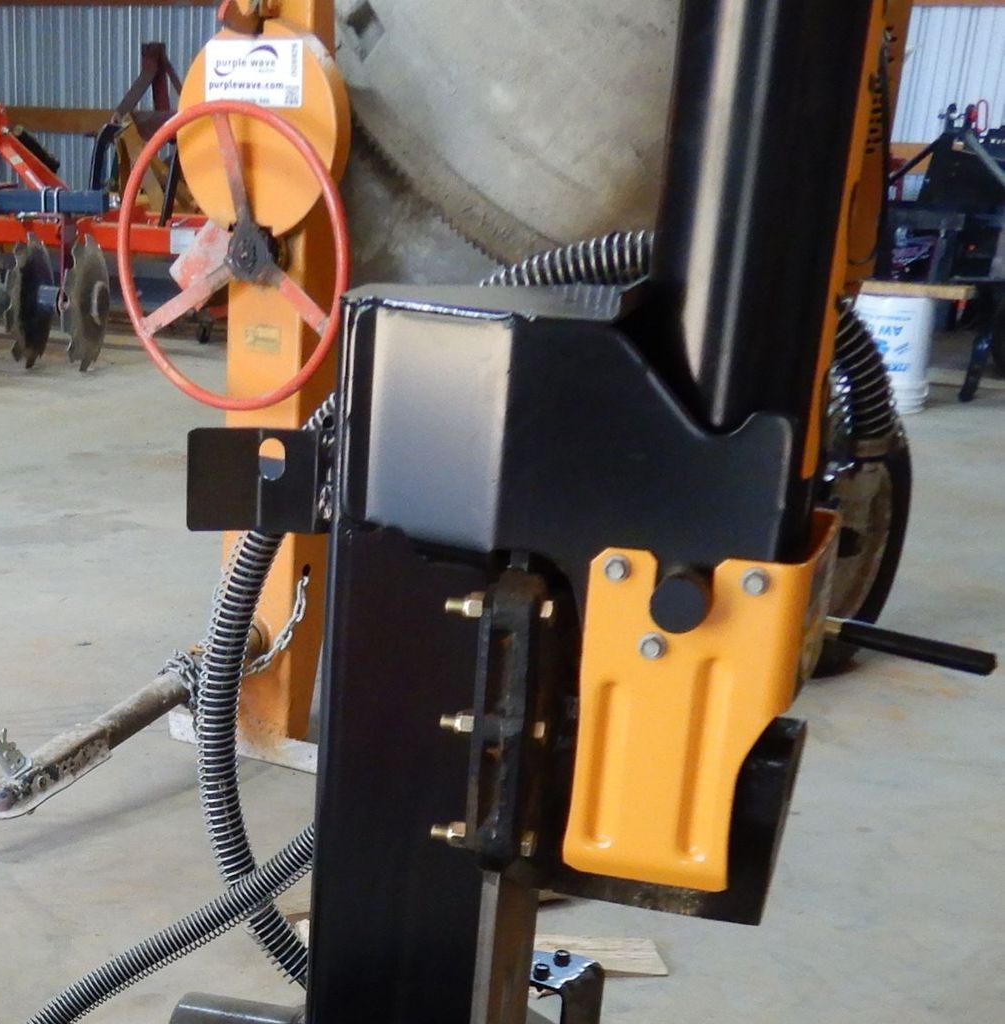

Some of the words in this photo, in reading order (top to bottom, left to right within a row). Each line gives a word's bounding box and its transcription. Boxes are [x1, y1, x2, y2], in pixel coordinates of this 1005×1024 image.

[216, 58, 246, 69] purple
[250, 59, 276, 67] wave
[208, 79, 284, 90] purplewave.com
